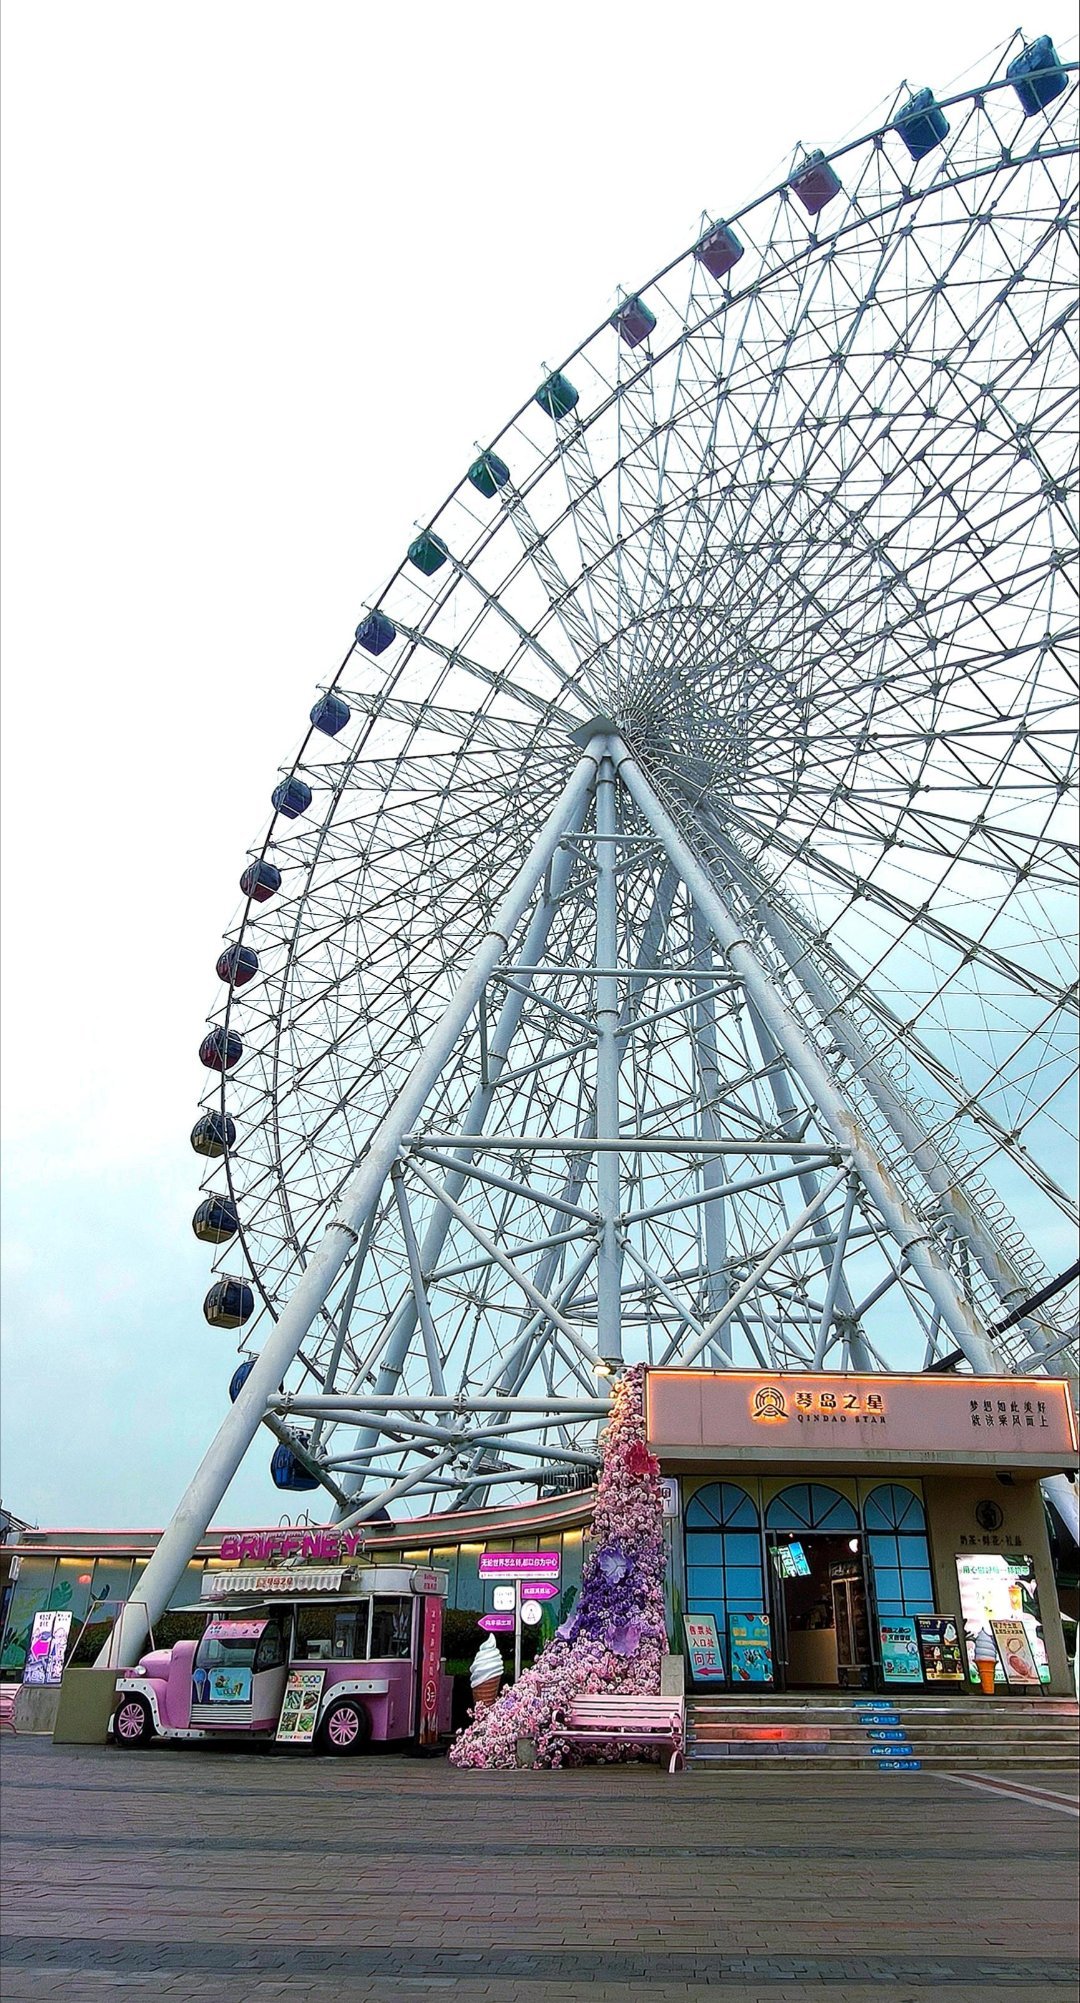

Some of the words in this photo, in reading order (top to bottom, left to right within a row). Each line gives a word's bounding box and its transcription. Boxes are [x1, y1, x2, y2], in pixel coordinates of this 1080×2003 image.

[796, 1391, 884, 1412] 琴岛之星
[970, 1400, 1046, 1413] 梦想如此美好
[797, 1414, 847, 1423] QINDAO
[855, 1415, 886, 1424] STAR
[971, 1415, 1049, 1427] 就该乘风而上
[220, 1530, 363, 1560] BRIFFNEY
[689, 1625, 713, 1636] 售票处
[692, 1638, 714, 1648] 入口处
[694, 1651, 716, 1666] 向左
